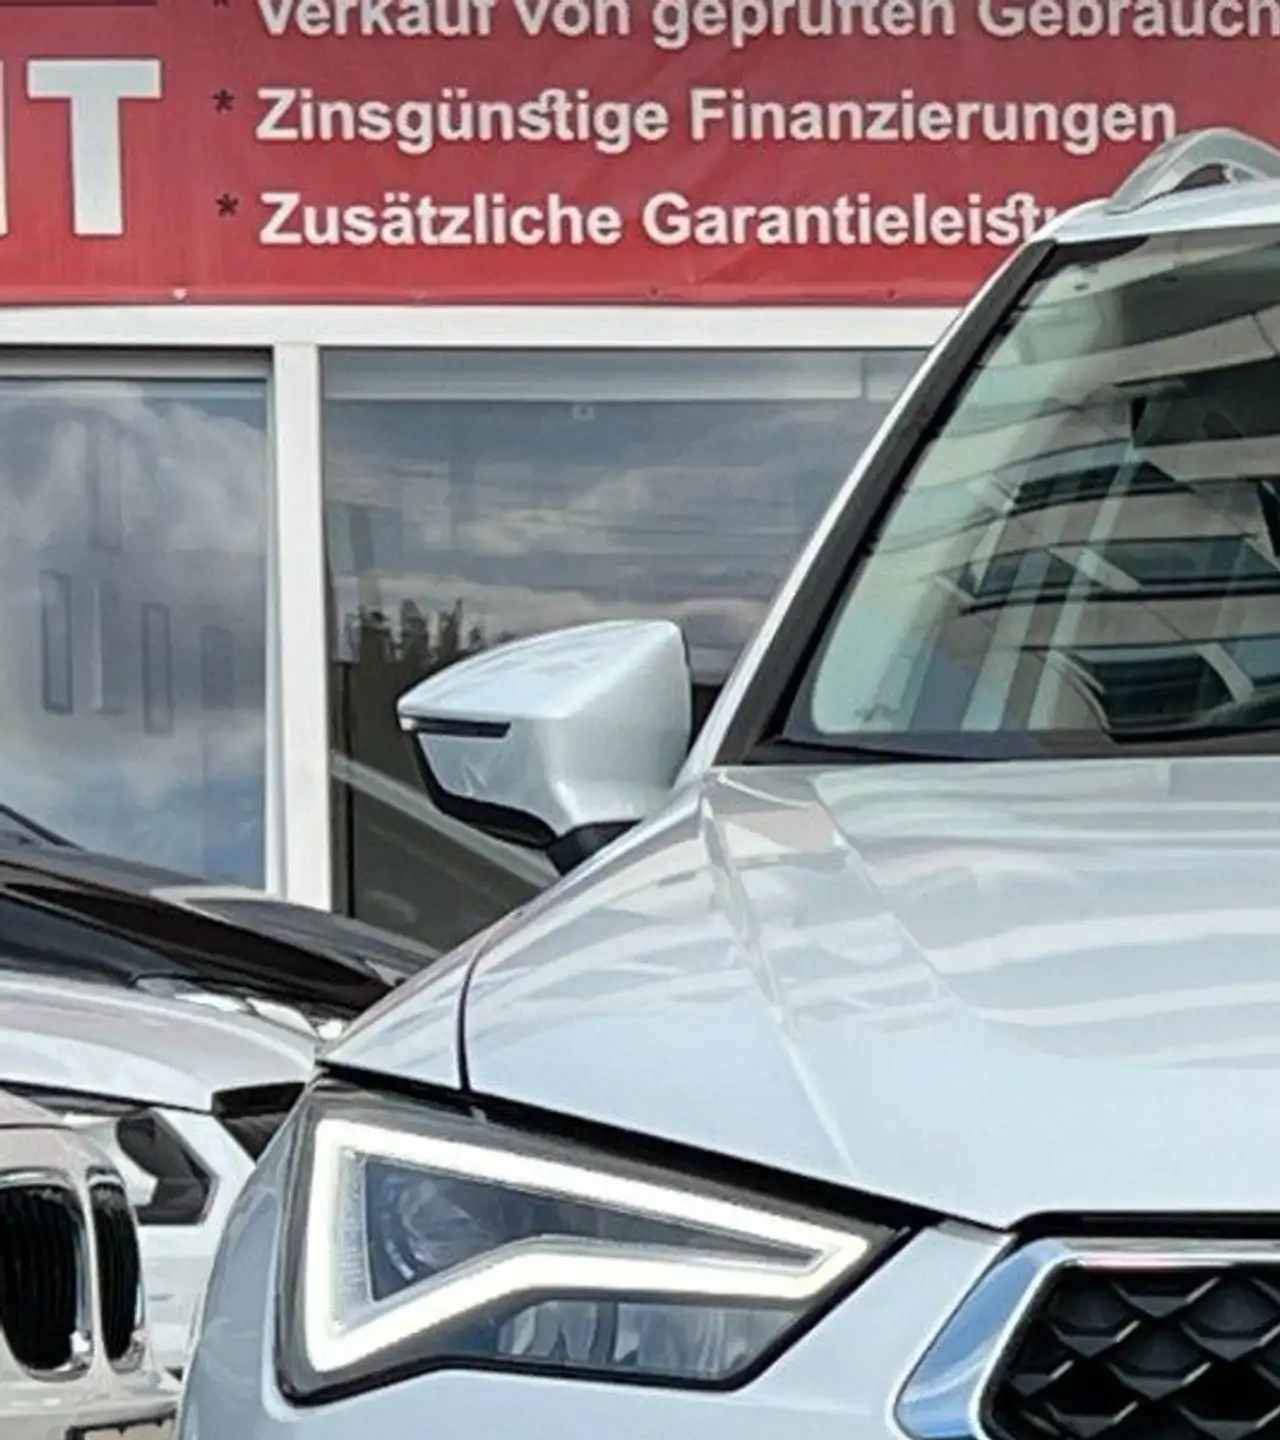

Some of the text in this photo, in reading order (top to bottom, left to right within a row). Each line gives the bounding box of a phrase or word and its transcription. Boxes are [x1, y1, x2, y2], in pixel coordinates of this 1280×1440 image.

[515, 0, 629, 36] von
[256, 88, 1175, 155] Zinsgünstige Finanzierungen
[259, 191, 1057, 245] Zusätzliche Garantieleist
